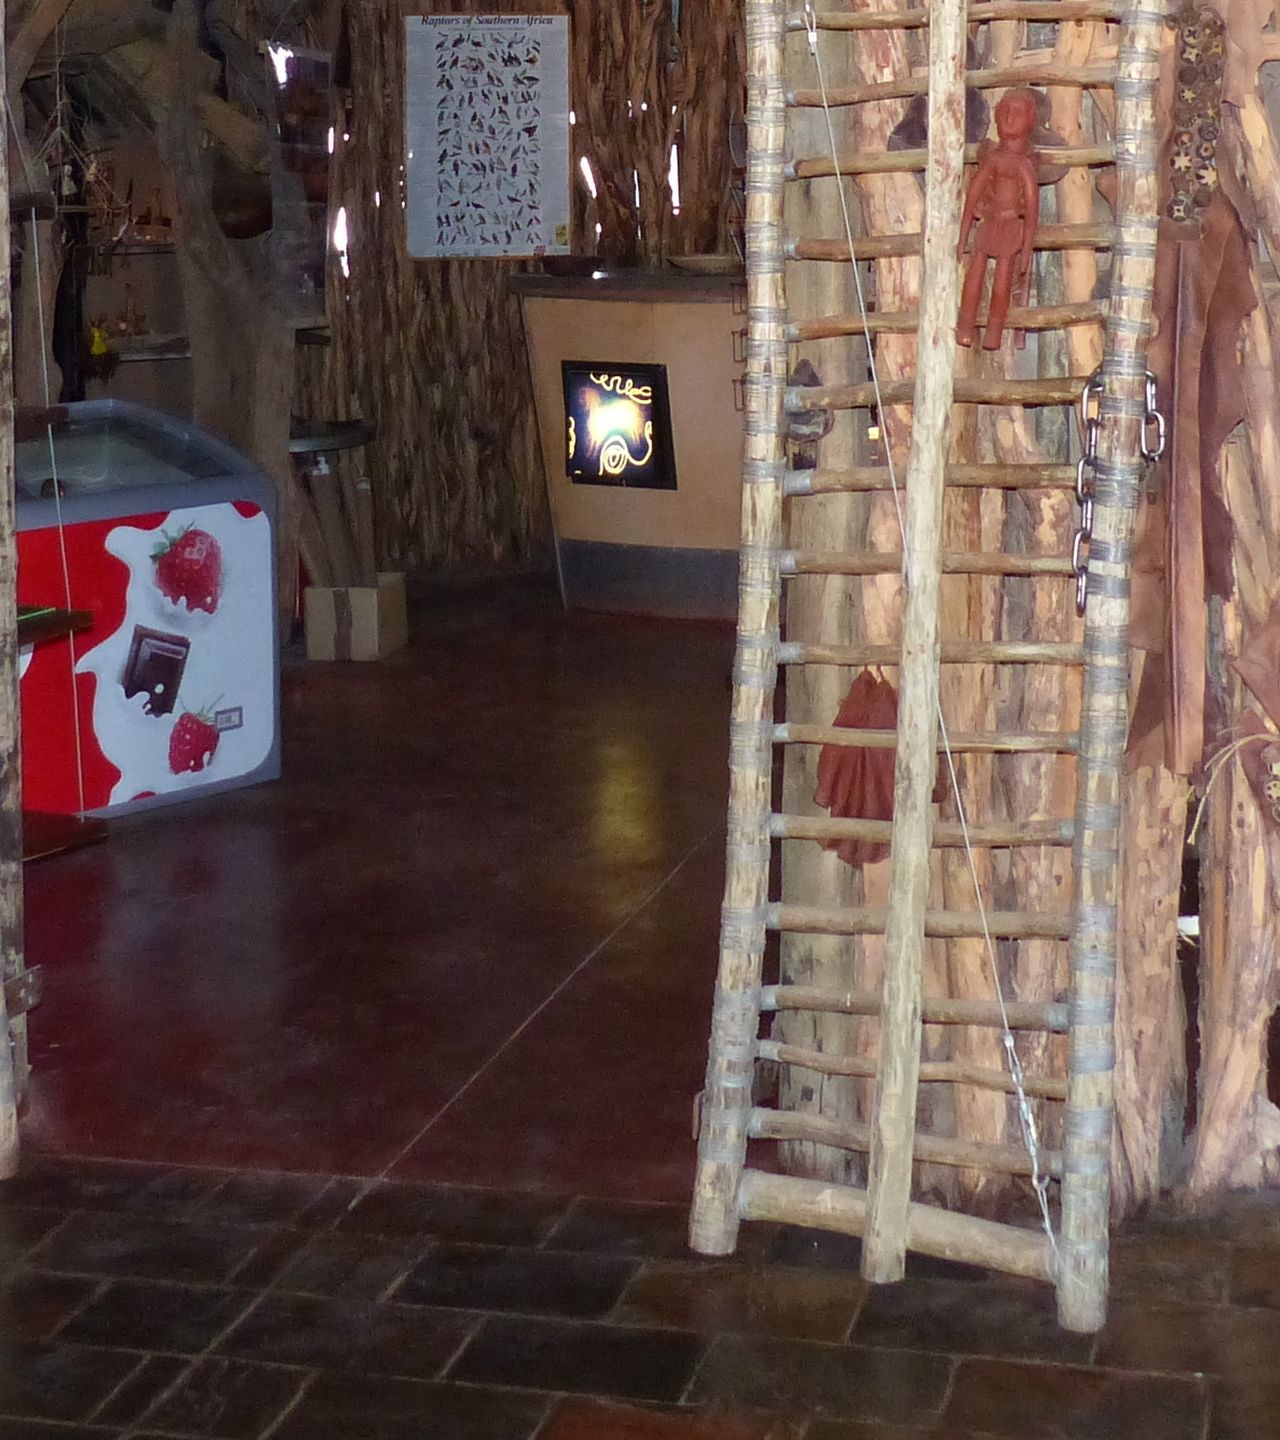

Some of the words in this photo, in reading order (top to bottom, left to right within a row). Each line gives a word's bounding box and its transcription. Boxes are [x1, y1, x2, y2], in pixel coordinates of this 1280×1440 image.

[421, 15, 460, 28] Raptors
[462, 15, 473, 27] of
[476, 15, 520, 26] Southern
[523, 15, 553, 27] Africa
